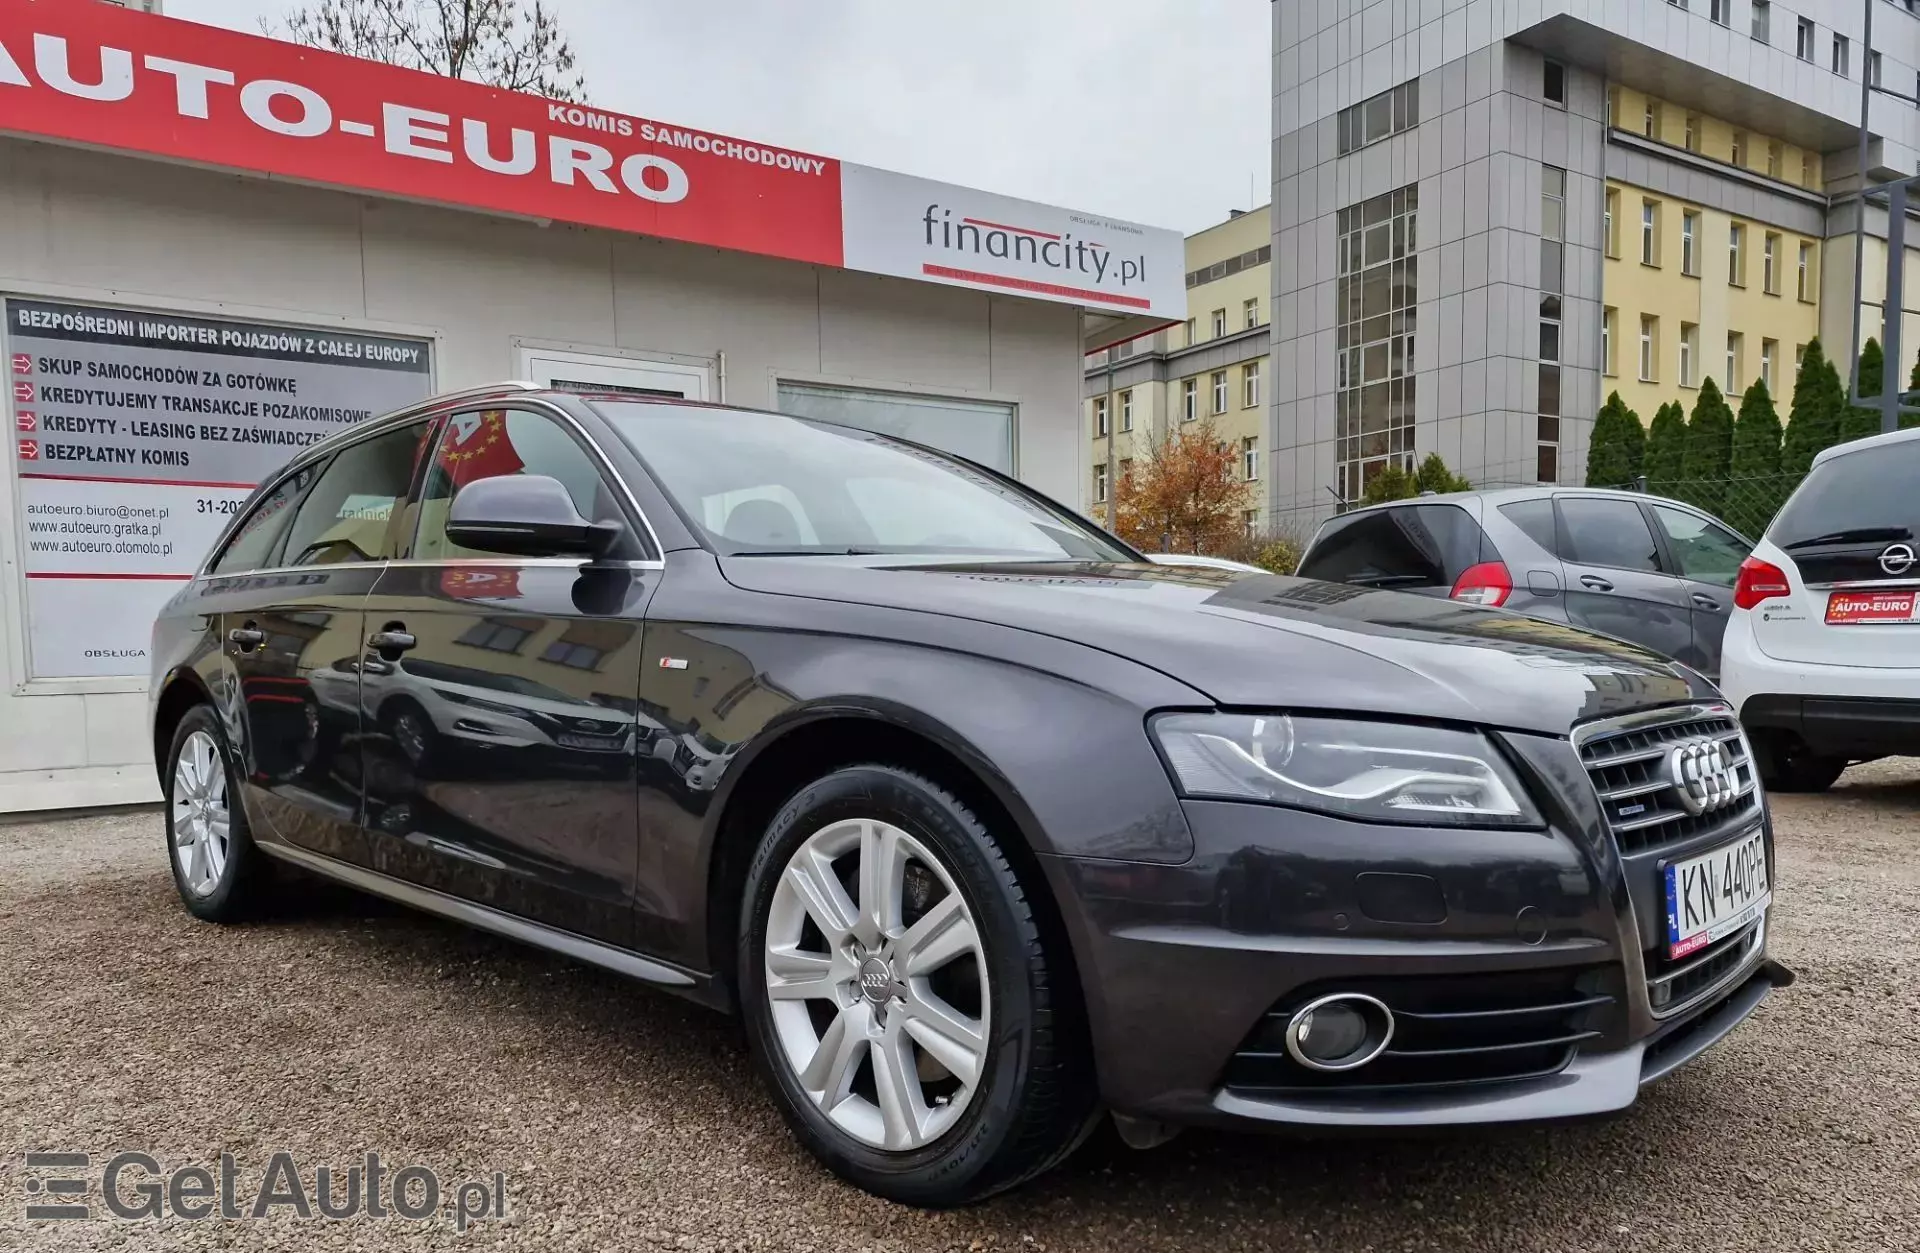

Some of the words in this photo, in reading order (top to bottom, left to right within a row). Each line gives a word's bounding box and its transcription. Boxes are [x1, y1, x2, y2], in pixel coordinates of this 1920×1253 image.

[549, 104, 632, 136] KOMIS
[641, 124, 825, 176] SAMOCHODOWY
[923, 204, 1145, 286] financity.pl
[18, 309, 134, 337] BEZPOŚREDNI
[139, 322, 218, 345] IMPORTER
[222, 330, 300, 353] POJAZDÓW
[305, 338, 315, 354] Z
[318, 339, 362, 358] CAŁEJ
[365, 344, 419, 364] EUROPY
[38, 357, 82, 376] SKUP
[87, 362, 198, 386] SAMOCHODÓW
[203, 371, 222, 388] ZA
[226, 373, 297, 397] GOTÓWKĘ
[41, 386, 157, 409] KREDYTUJEMY
[162, 395, 259, 417] TRANSAKCJE
[263, 403, 372, 423] POZAKOMISOWE
[43, 415, 117, 435] KREDYTY
[131, 421, 196, 440] LEASING
[200, 425, 228, 442] BEZ
[232, 425, 331, 447] ZAŚWIADCZE
[45, 443, 136, 464] BEZPŁATNY
[141, 449, 190, 467] KOMIS
[27, 503, 169, 520] autoeuro.biuro@onet.pl
[29, 520, 161, 538] www.autoeuro.gratka.pl
[30, 540, 173, 556] www.autoeuro.otomoto.pl
[1835, 601, 1910, 612] AUTO-EURO
[84, 649, 146, 658] OBSŁUGA
[1682, 859, 1717, 930] KN
[1722, 834, 1765, 910] 440PE
[1674, 934, 1707, 956] AUTO-EURO
